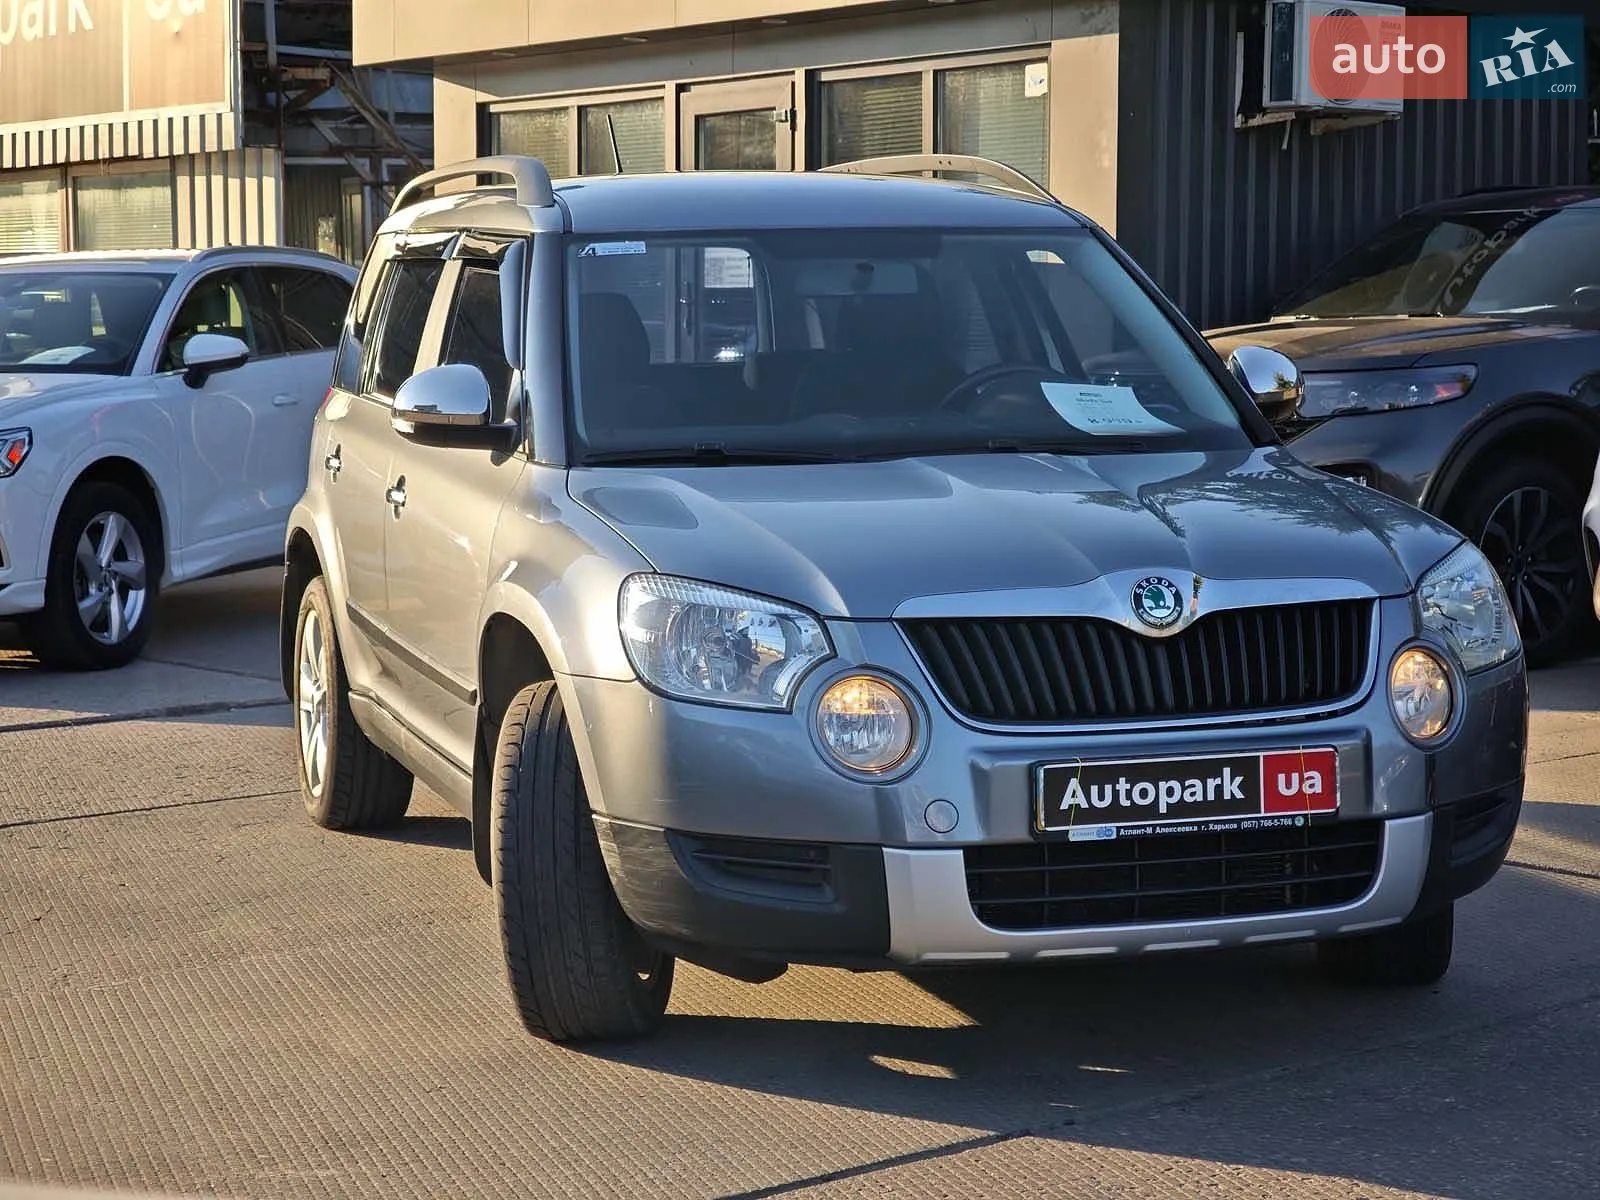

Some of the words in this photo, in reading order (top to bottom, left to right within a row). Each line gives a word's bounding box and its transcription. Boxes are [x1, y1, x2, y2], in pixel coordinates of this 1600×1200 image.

[1059, 767, 1246, 814] Autopark
[1277, 769, 1323, 797] ua
[1208, 822, 1238, 832] Харьков
[1241, 819, 1259, 829] (057)
